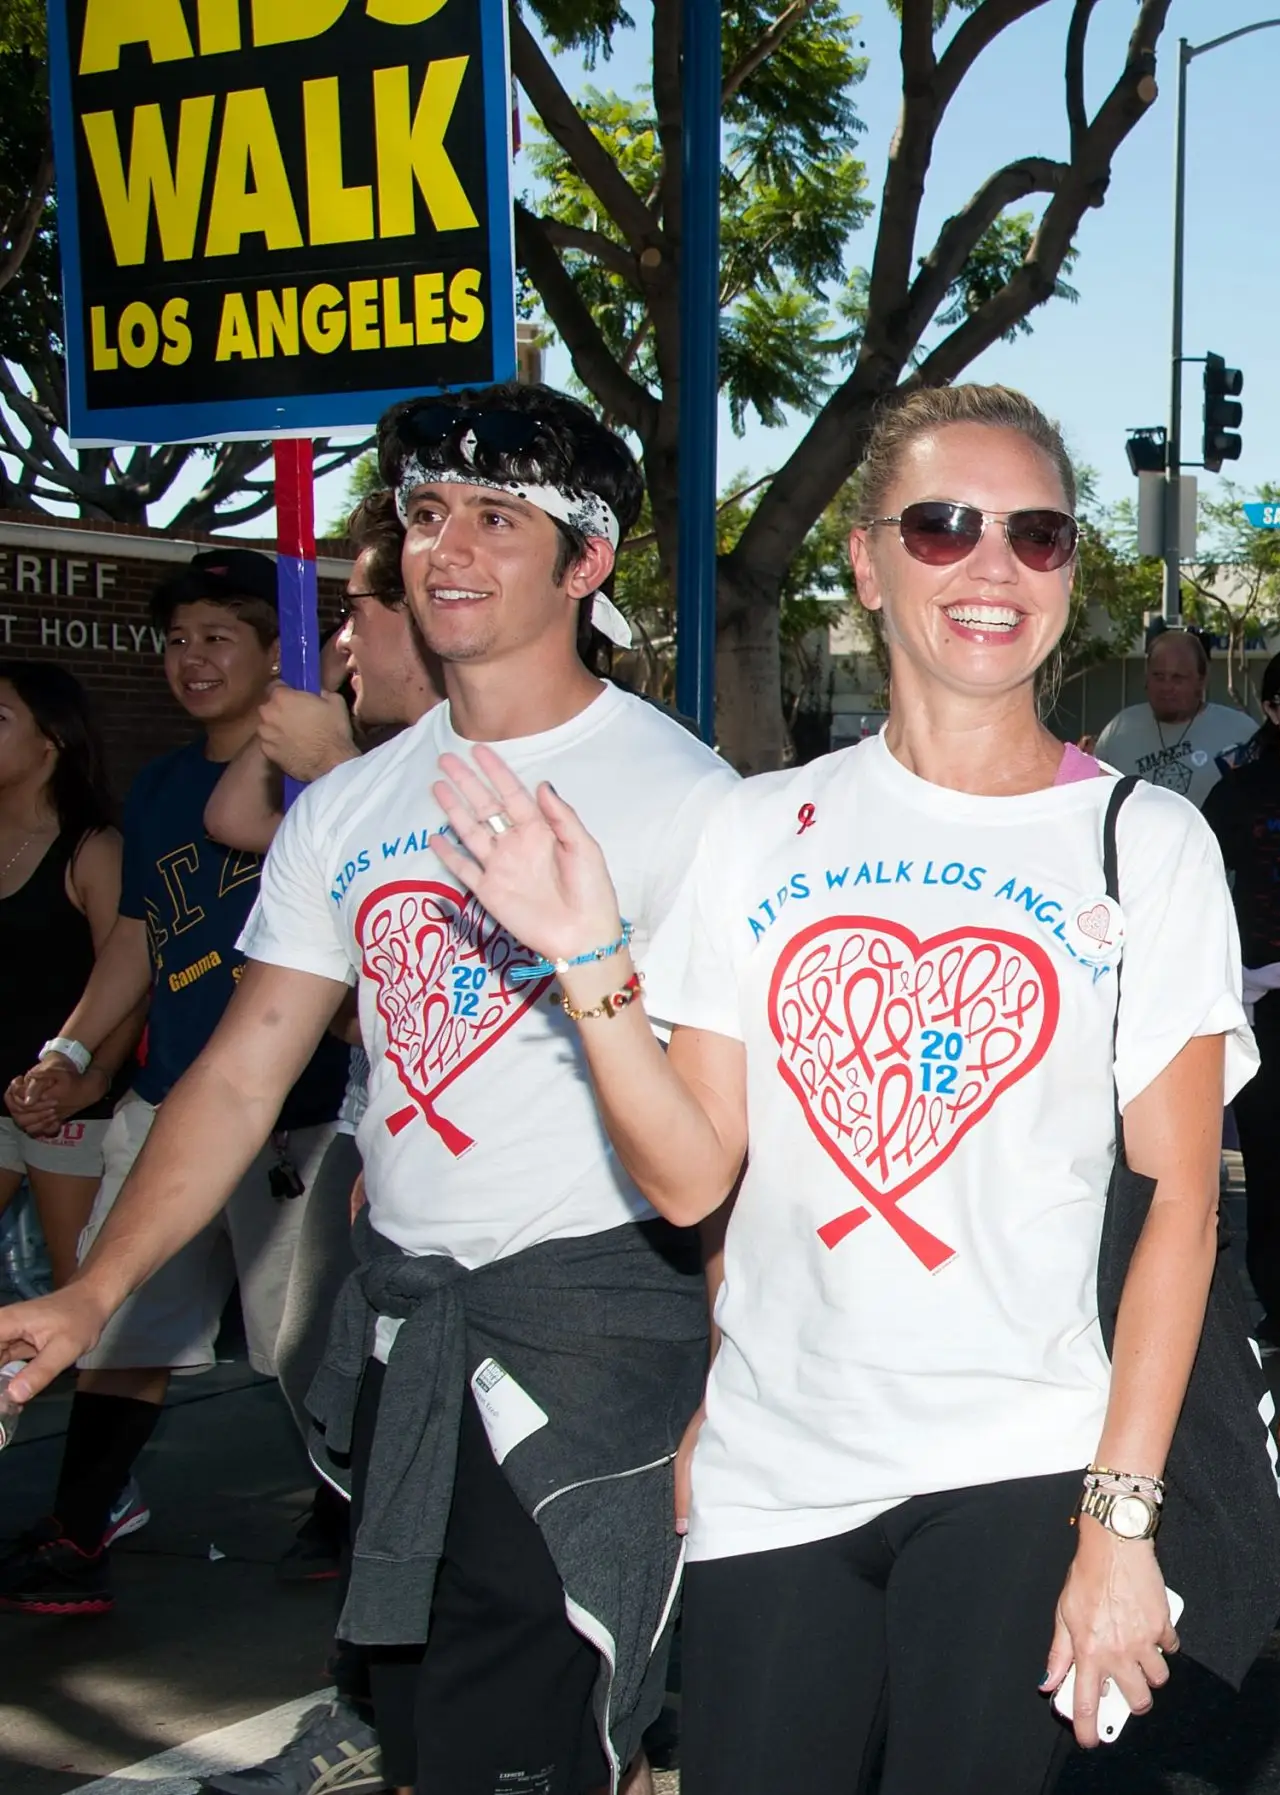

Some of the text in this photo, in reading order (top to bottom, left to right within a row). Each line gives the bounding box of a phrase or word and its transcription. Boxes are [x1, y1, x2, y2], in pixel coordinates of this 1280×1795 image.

[81, 54, 480, 267] WALK
[90, 267, 485, 372] LOS ANGELES
[329, 850, 372, 909] AIDS
[745, 872, 812, 943] AIDS
[825, 860, 914, 889] WALK
[921, 860, 989, 893] LOS
[168, 949, 222, 992] Gamma
[451, 965, 487, 990] 20
[452, 991, 480, 1017] 12
[919, 1029, 964, 1061] 20
[918, 1062, 959, 1095] 12
